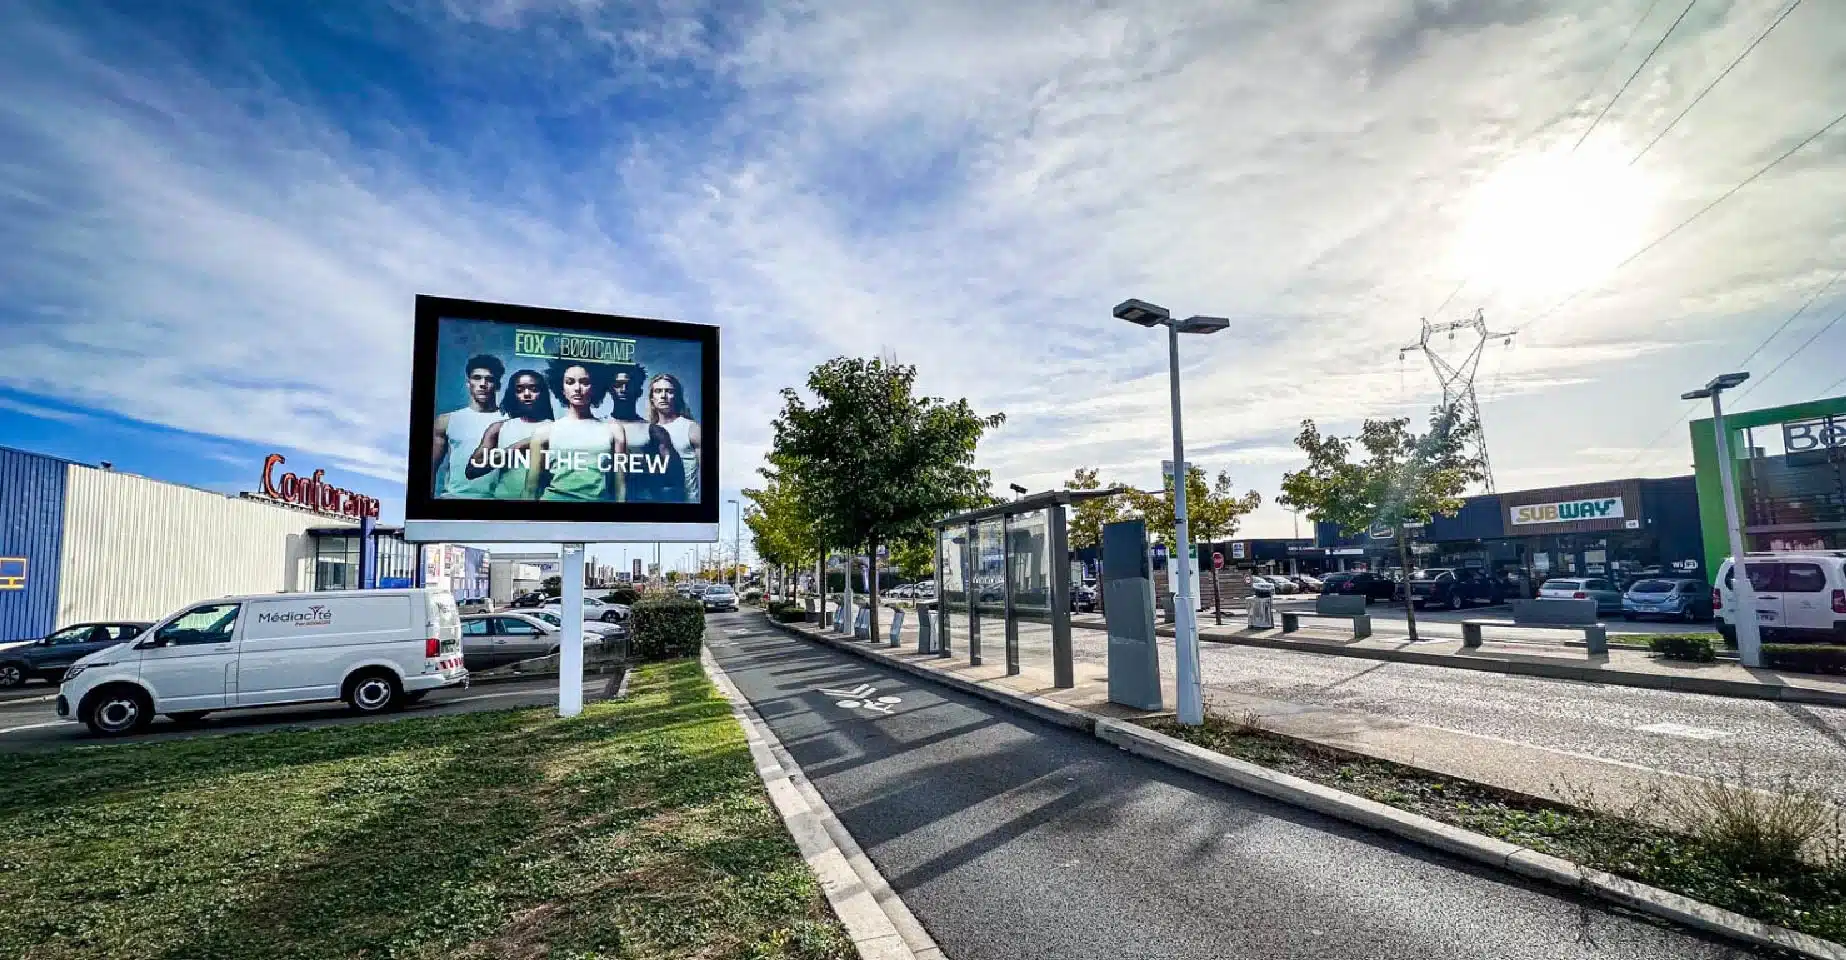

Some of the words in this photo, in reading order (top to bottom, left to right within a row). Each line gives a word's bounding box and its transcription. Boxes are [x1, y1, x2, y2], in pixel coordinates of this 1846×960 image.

[515, 333, 546, 354] FOX
[470, 447, 531, 469] JOIN
[541, 449, 589, 471] THE
[597, 453, 670, 474] CREW
[263, 453, 380, 520] Conforama
[1516, 499, 1616, 523] SUBWAY
